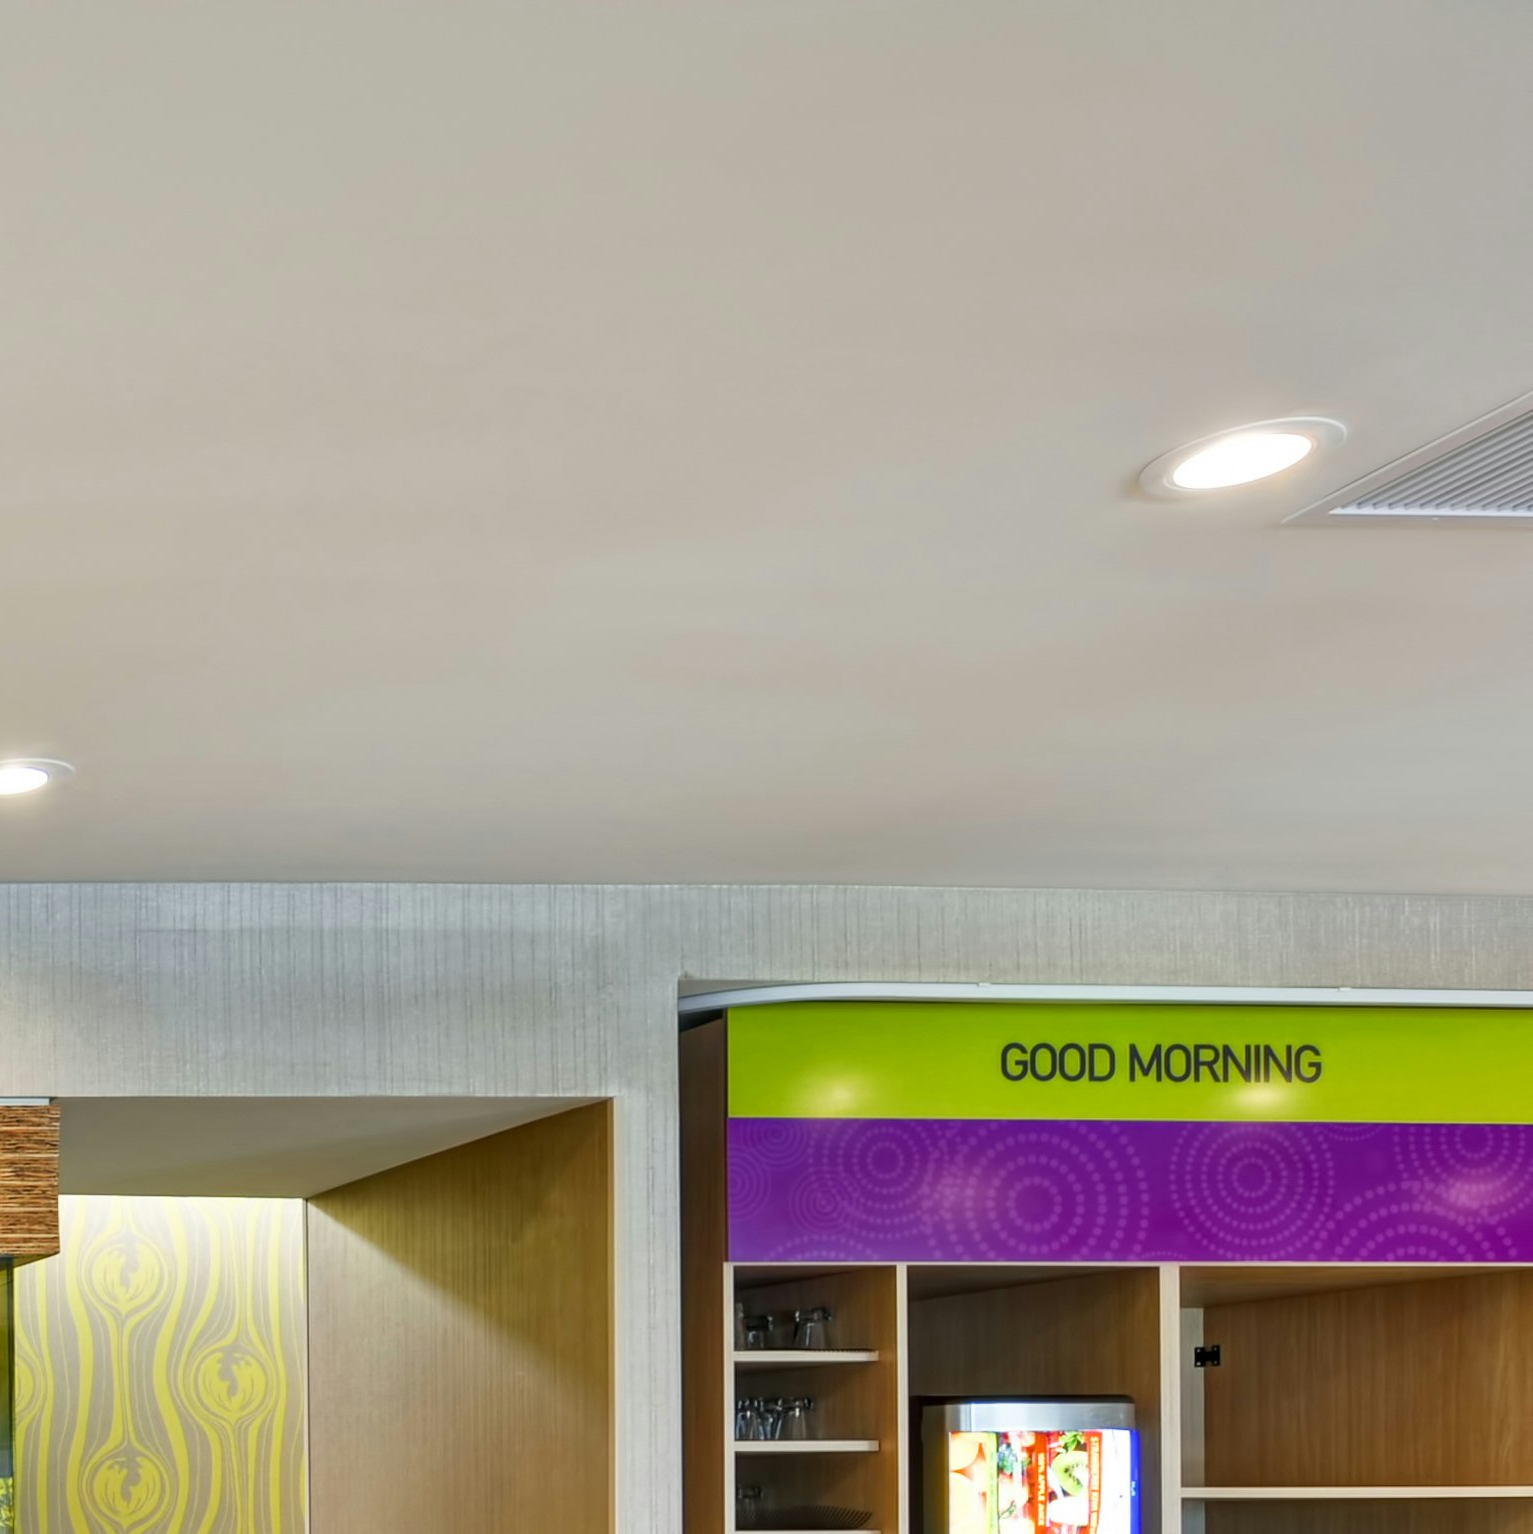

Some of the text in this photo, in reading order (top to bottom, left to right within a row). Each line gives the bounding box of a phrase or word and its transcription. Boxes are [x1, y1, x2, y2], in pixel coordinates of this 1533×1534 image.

[1001, 1042, 1322, 1083] GOOD MORNING
[1038, 1474, 1046, 1501] APPLE
